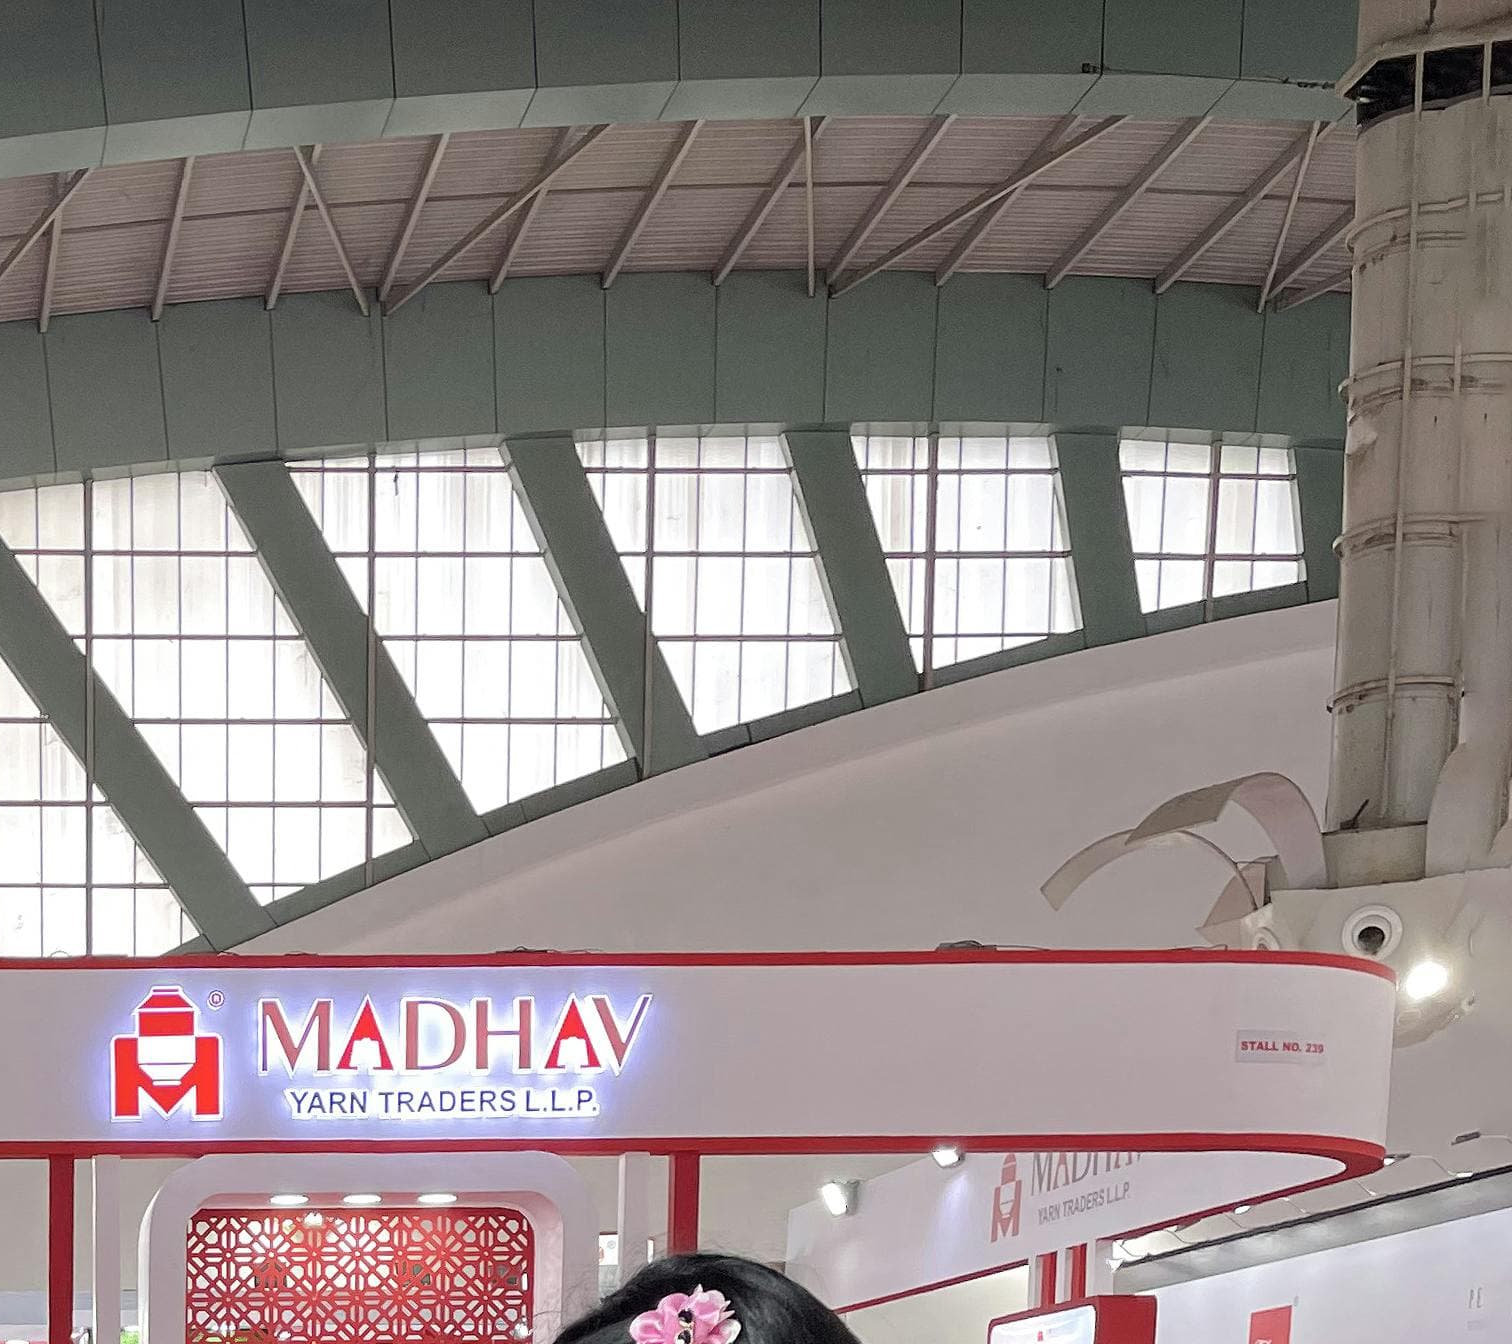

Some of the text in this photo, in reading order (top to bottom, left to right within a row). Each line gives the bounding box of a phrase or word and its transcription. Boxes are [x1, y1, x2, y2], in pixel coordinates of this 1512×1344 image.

[260, 994, 652, 1075] MADHAV
[1240, 1041, 1279, 1051] STALL
[1282, 1042, 1302, 1052] NO.
[290, 1090, 368, 1115] YARN
[380, 1089, 516, 1114] TRADERS
[1036, 1204, 1060, 1225] YARN
[1062, 1188, 1105, 1218] TRADERS
